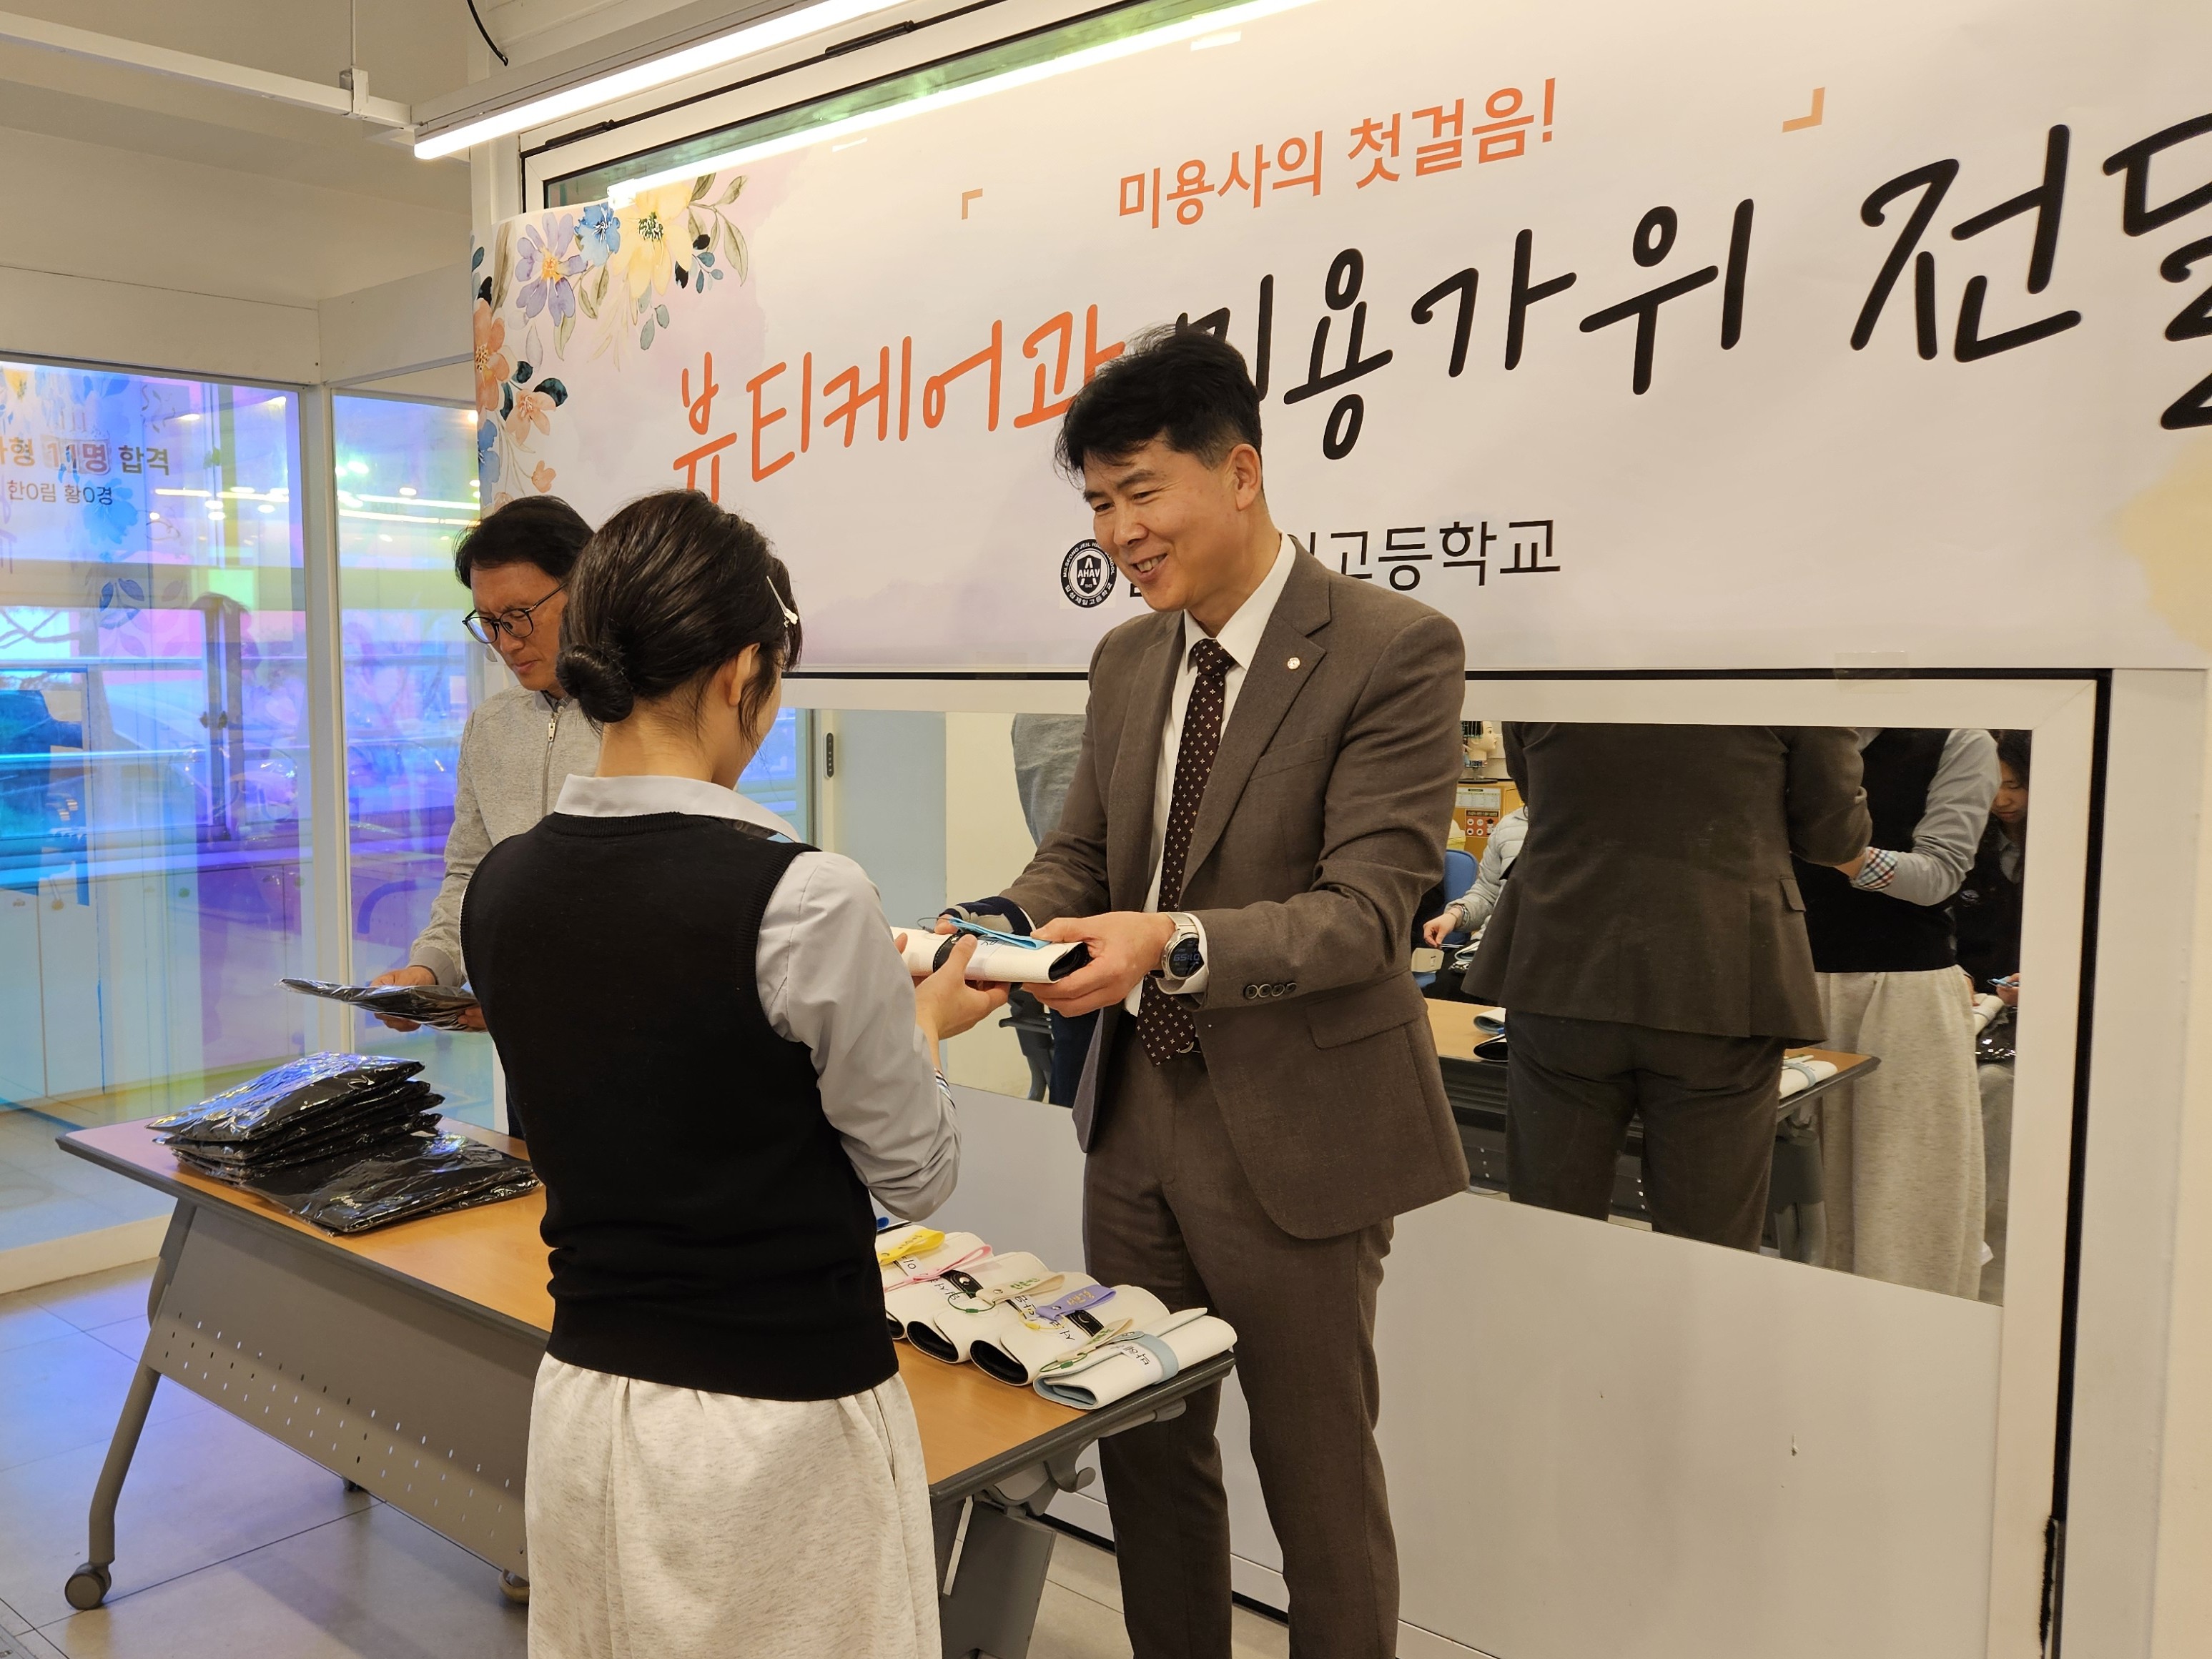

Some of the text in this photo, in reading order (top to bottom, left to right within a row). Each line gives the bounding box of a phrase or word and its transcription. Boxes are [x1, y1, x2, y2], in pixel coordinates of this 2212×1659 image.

[1119, 77, 1556, 229] 미용사의 첫걸음!
[673, 303, 1126, 505] 뷰티케어과
[0, 437, 35, 467] 형
[118, 445, 169, 475] 합격
[1077, 568, 1100, 578] AHAV
